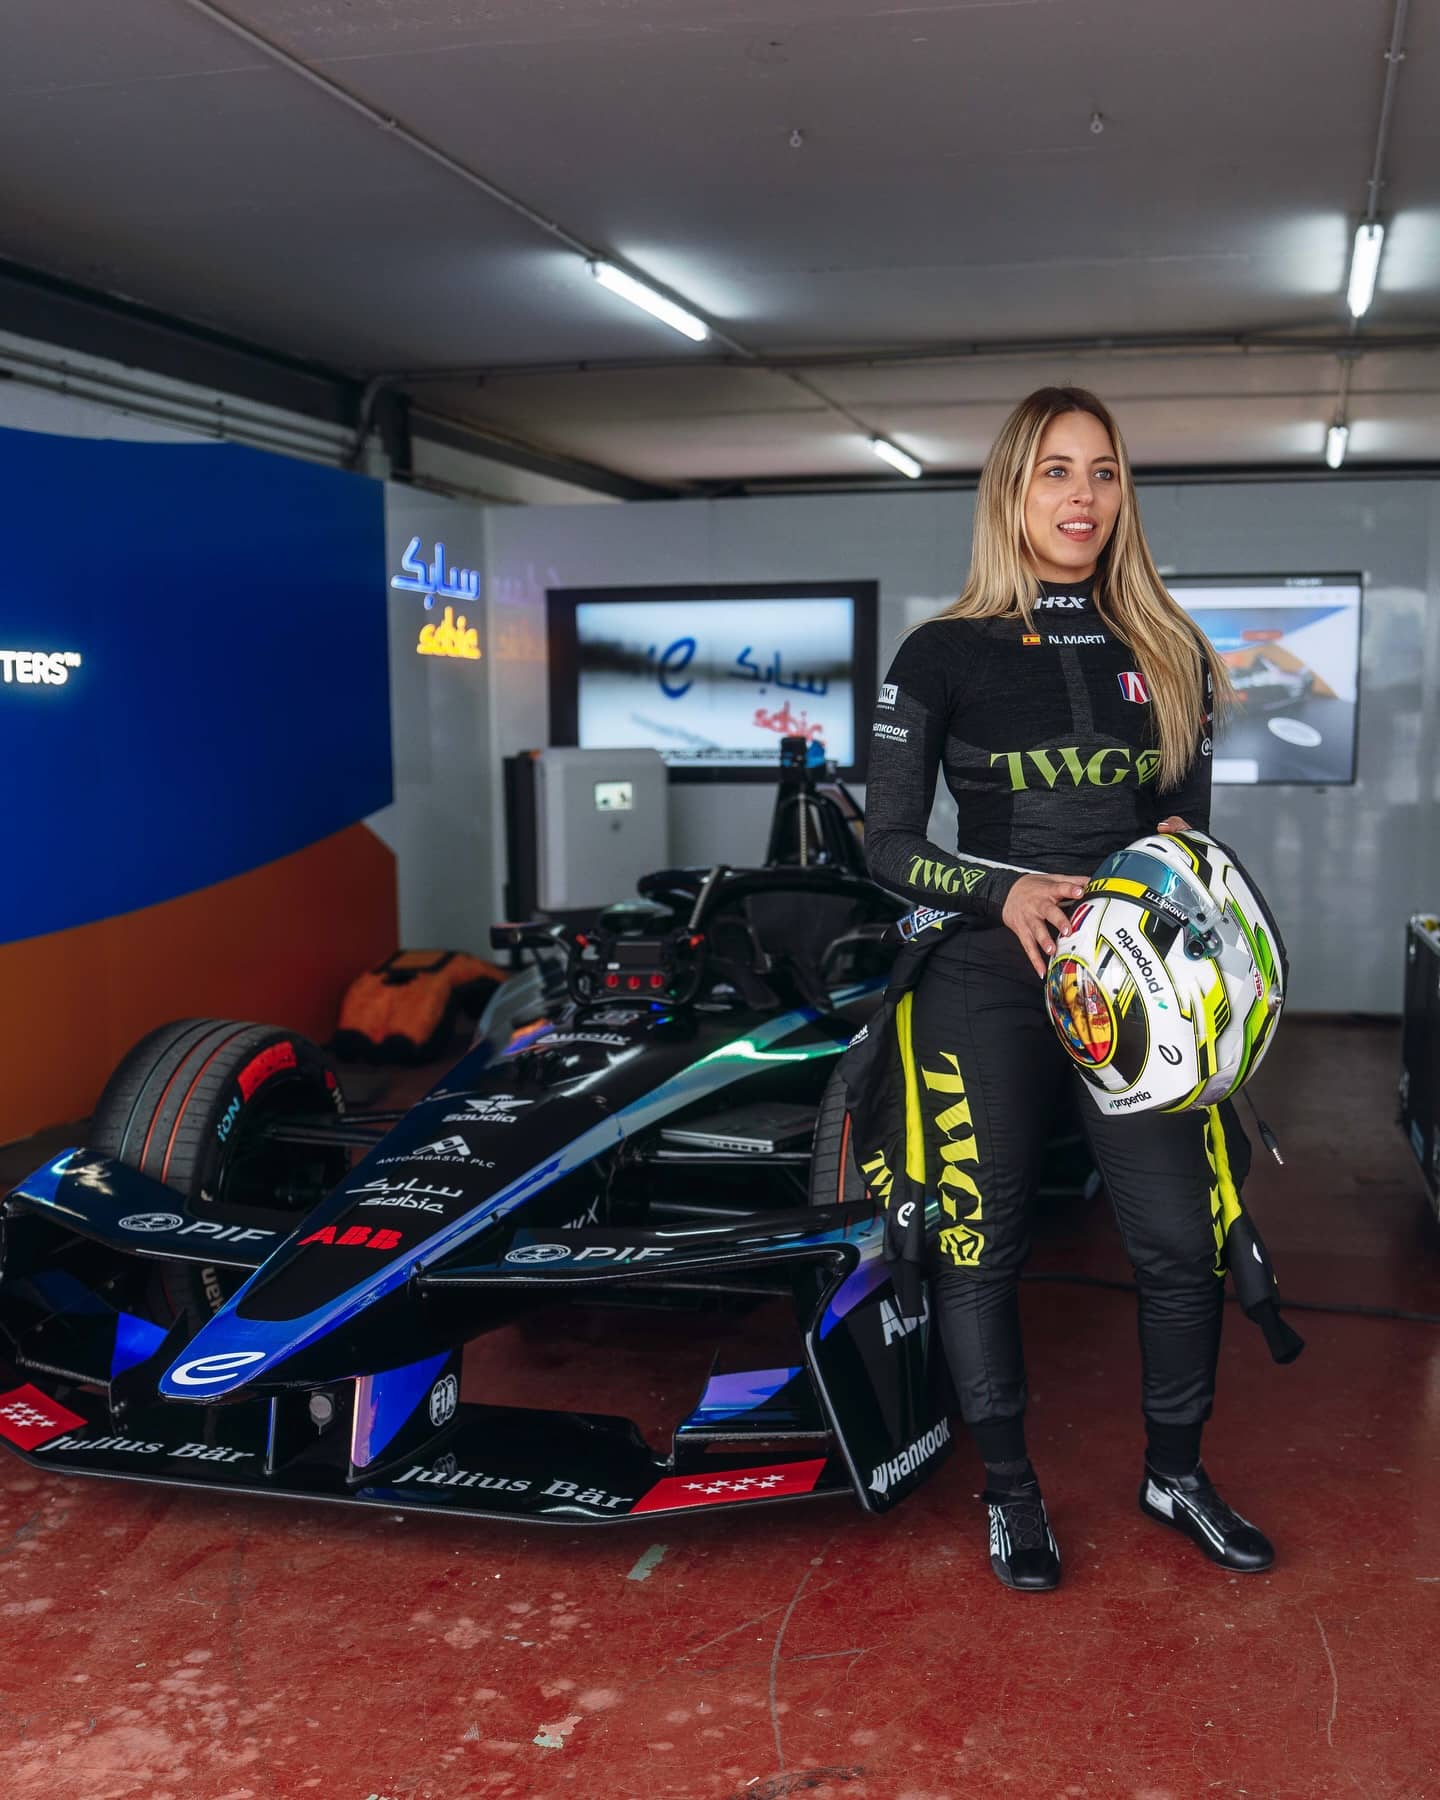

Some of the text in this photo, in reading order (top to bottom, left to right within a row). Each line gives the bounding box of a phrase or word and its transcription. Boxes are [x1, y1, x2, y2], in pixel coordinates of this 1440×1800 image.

[1034, 596, 1087, 610] HRX
[990, 747, 1131, 791] TWG
[907, 855, 961, 894] TWG
[1145, 892, 1188, 921] ANDRETTI
[1115, 928, 1163, 994] propertia
[1114, 1090, 1152, 1111] propertia
[921, 1051, 983, 1221] TWG
[376, 1155, 496, 1169] ANTOFAGASTA PLC
[176, 1221, 276, 1243] PIF
[297, 1225, 403, 1250] ABB
[573, 1247, 675, 1262] PIF
[35, 1436, 255, 1463] Julius Bär
[392, 1465, 633, 1509] Julius Bär
